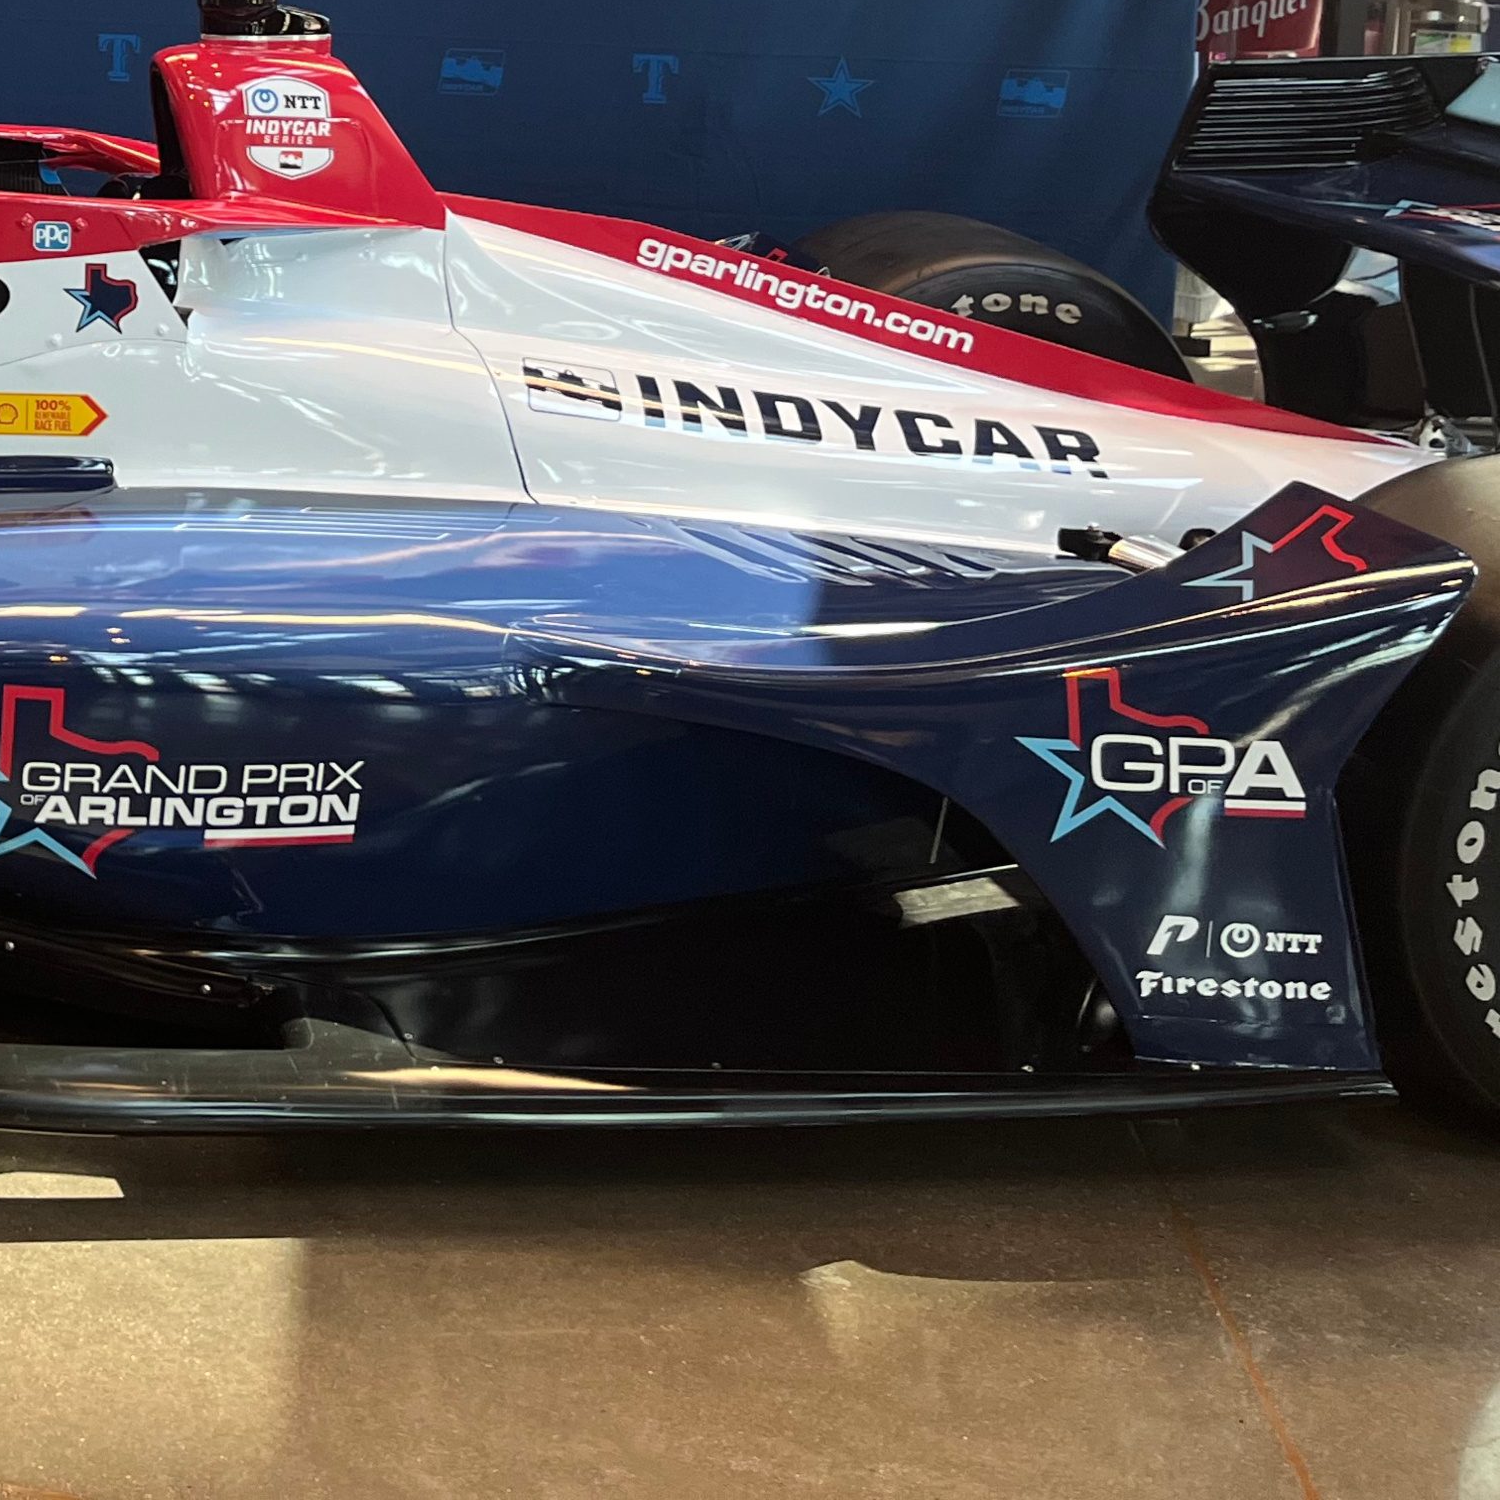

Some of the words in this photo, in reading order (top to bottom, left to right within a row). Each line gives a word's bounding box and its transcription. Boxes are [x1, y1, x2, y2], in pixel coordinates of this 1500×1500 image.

[97, 33, 141, 82] T
[632, 53, 680, 104] T
[283, 94, 321, 110] NTT
[246, 119, 331, 136] INDYCAR
[264, 135, 313, 145] SERIES
[35, 224, 69, 247] PPG
[636, 238, 973, 353] gparlington.com
[35, 400, 71, 410] 100%
[635, 375, 1110, 479] INDYCAR
[22, 761, 228, 795] GRAND
[242, 760, 366, 795] PRIX
[20, 794, 47, 806] OF
[34, 793, 360, 827] ARLINGTON
[1266, 932, 1322, 955] NTT
[1135, 970, 1332, 1000] Firestone
